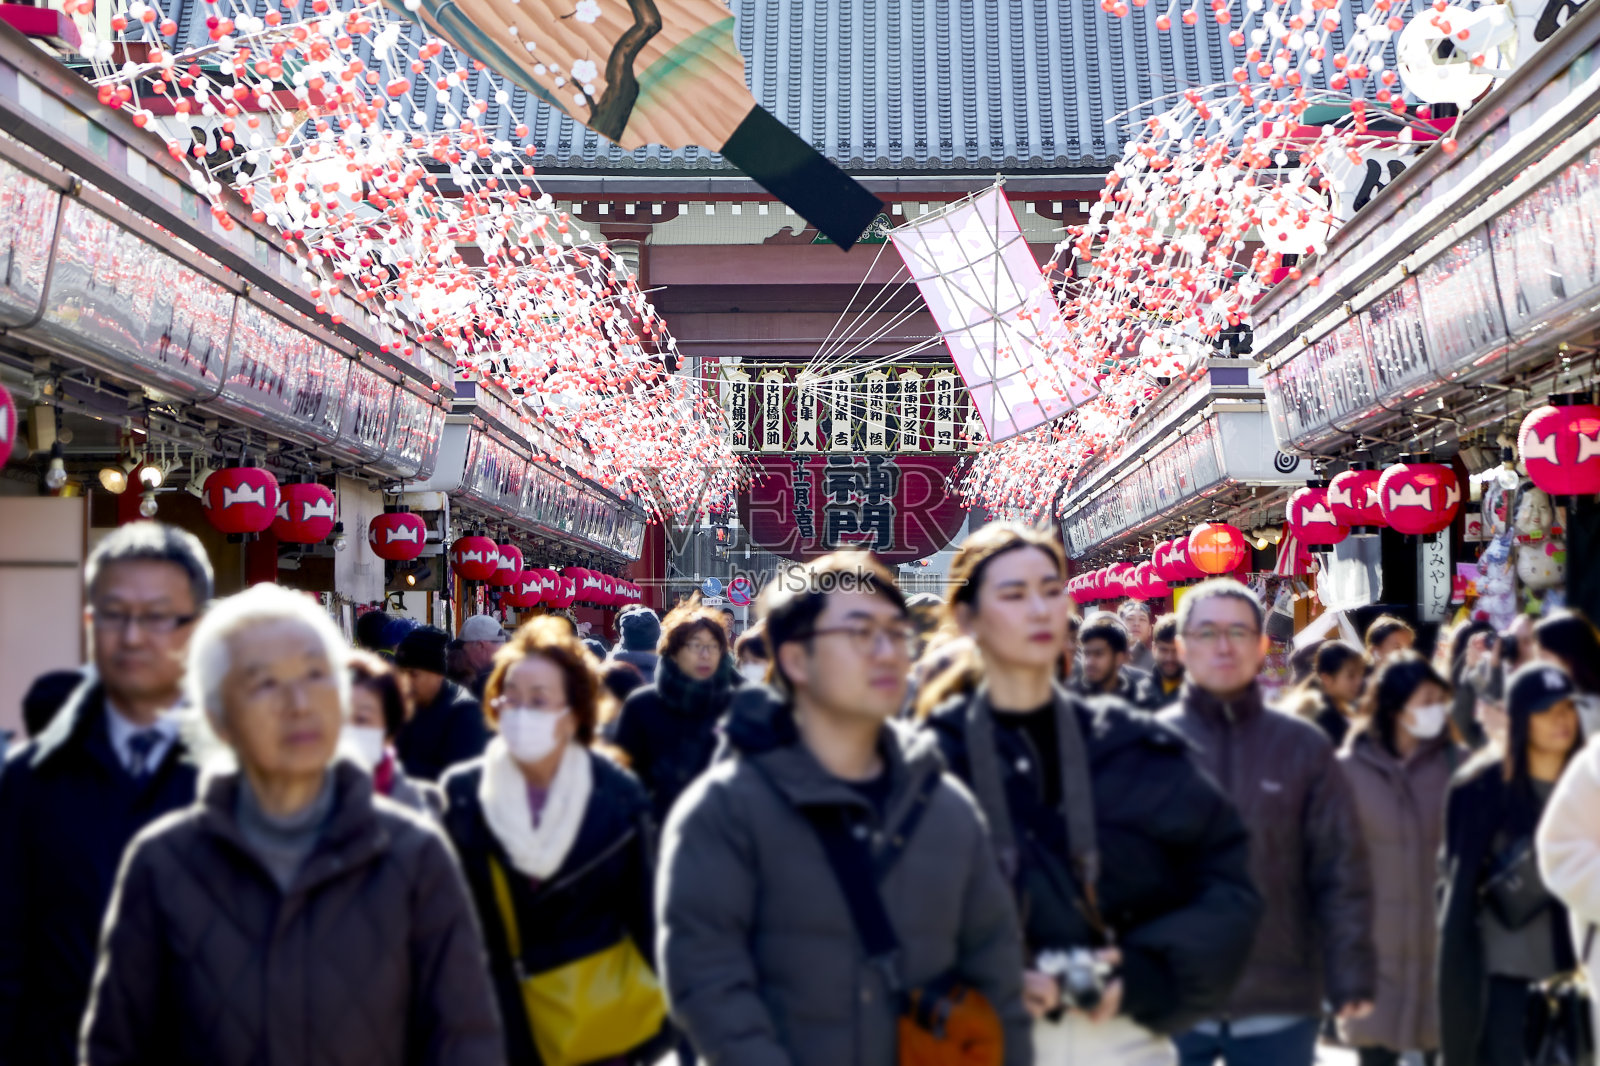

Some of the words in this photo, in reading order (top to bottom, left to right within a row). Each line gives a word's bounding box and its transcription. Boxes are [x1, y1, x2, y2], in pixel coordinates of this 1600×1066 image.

[766, 380, 780, 446] 中村橋之助
